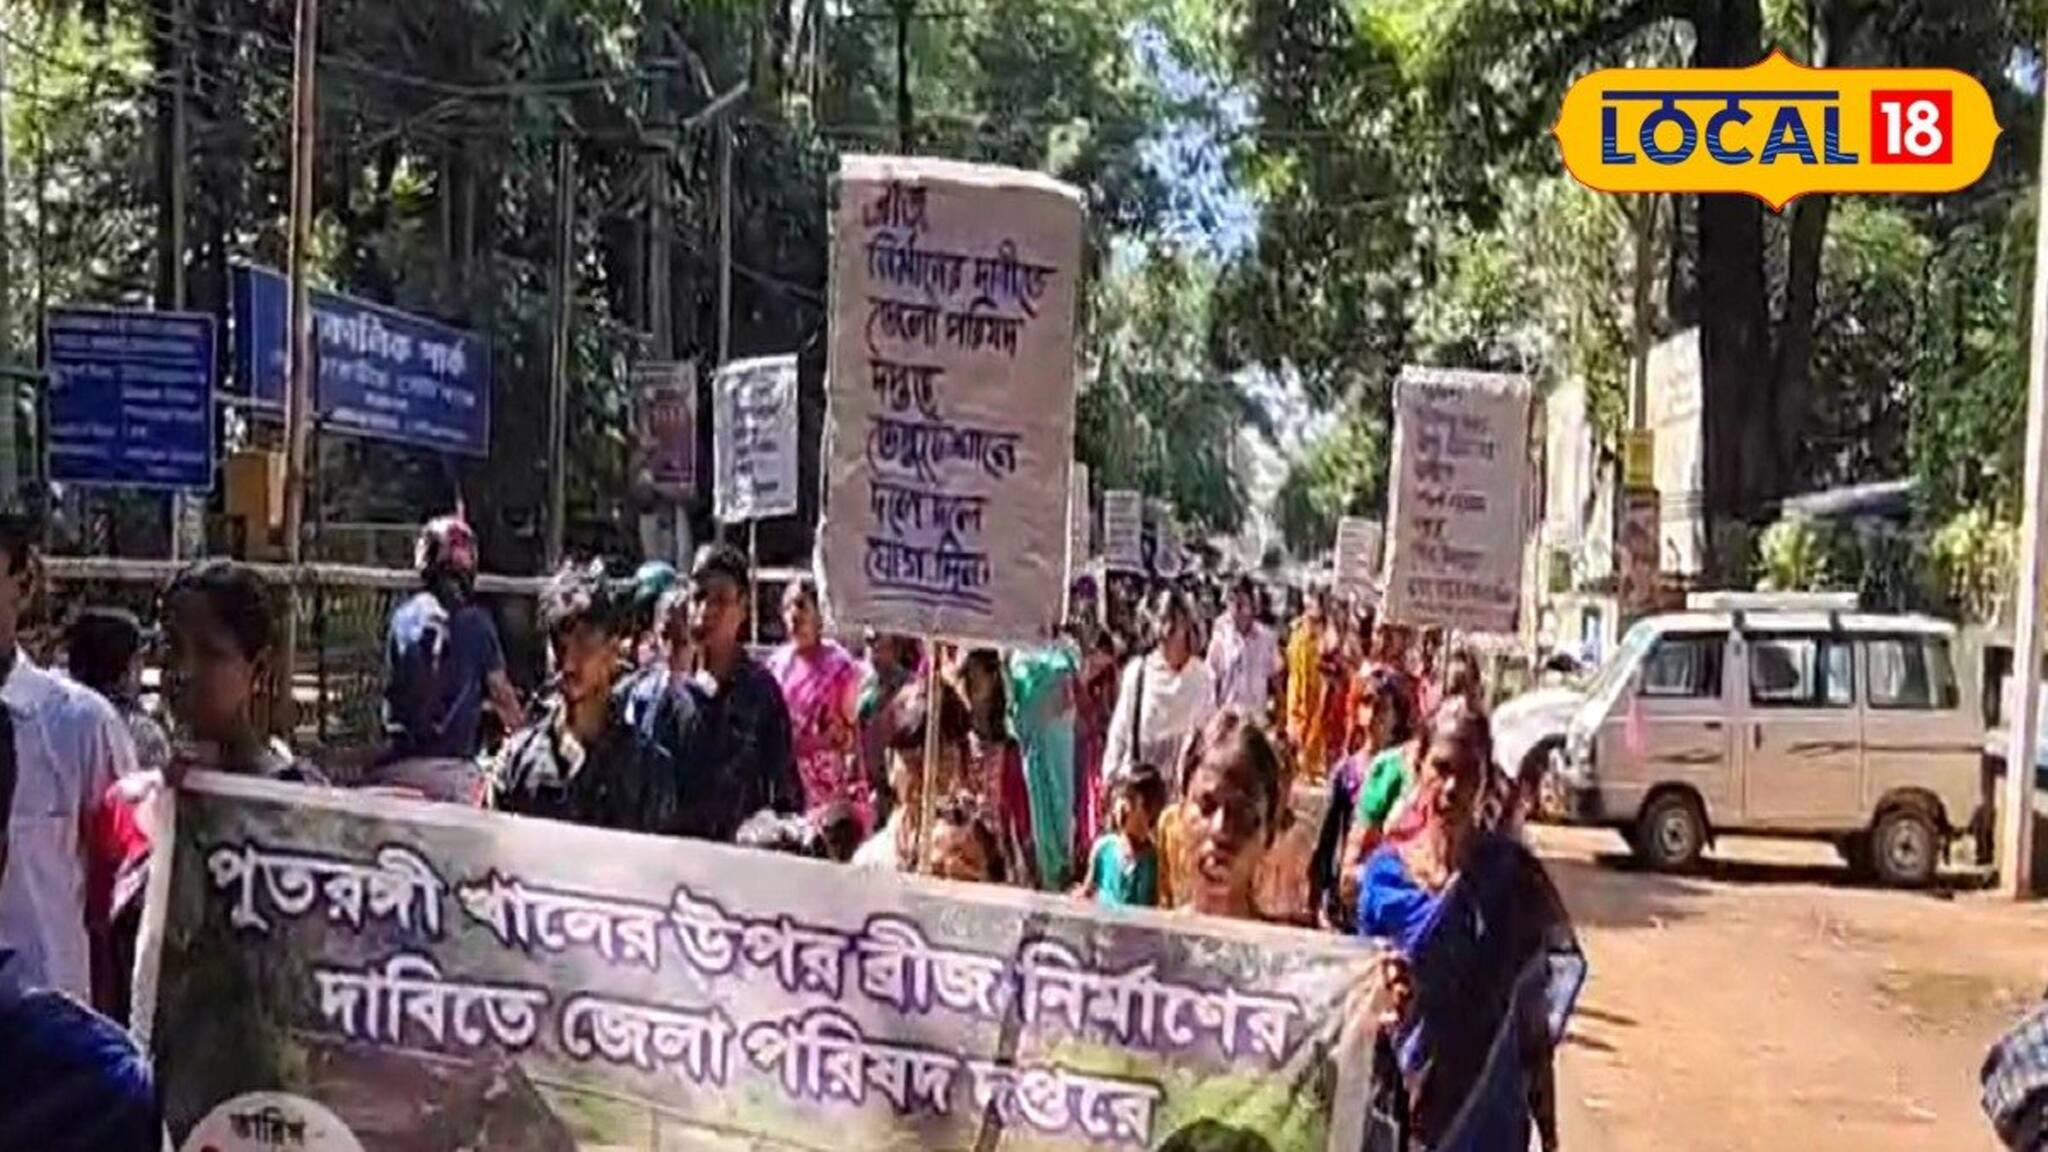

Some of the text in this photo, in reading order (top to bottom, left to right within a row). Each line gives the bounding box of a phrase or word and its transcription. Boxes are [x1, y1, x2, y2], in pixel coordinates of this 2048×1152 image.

[313, 954, 1162, 1149] দাবিতে জেলা পরিষদ দপ্তরে
[458, 878, 668, 970] খালের
[670, 887, 847, 998] উপর
[856, 916, 1003, 1014] ব্রীজ
[1014, 938, 1300, 1062] নির্মাণের
